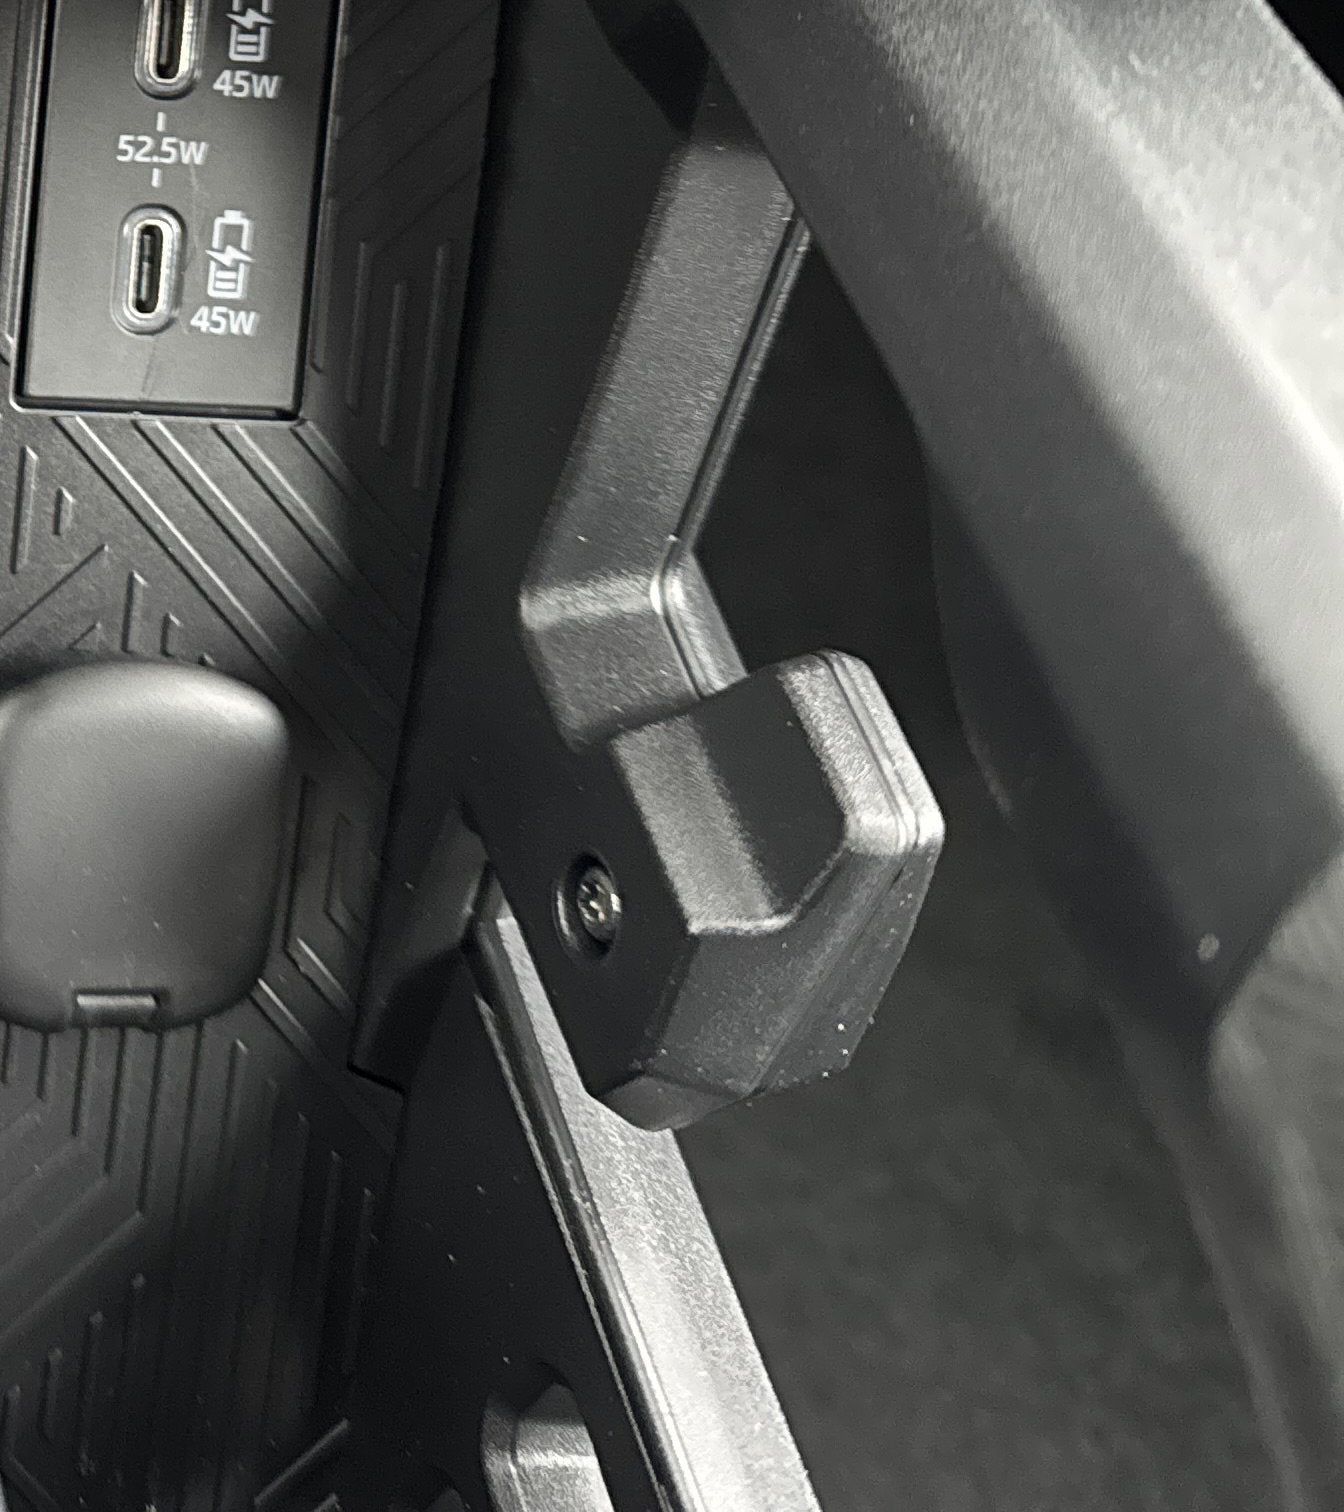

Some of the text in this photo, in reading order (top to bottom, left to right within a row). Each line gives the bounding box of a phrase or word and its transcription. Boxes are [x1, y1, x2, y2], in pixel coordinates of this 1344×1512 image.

[212, 69, 282, 99] 45W
[116, 135, 210, 165] 52.5W
[190, 305, 260, 337] 45W
